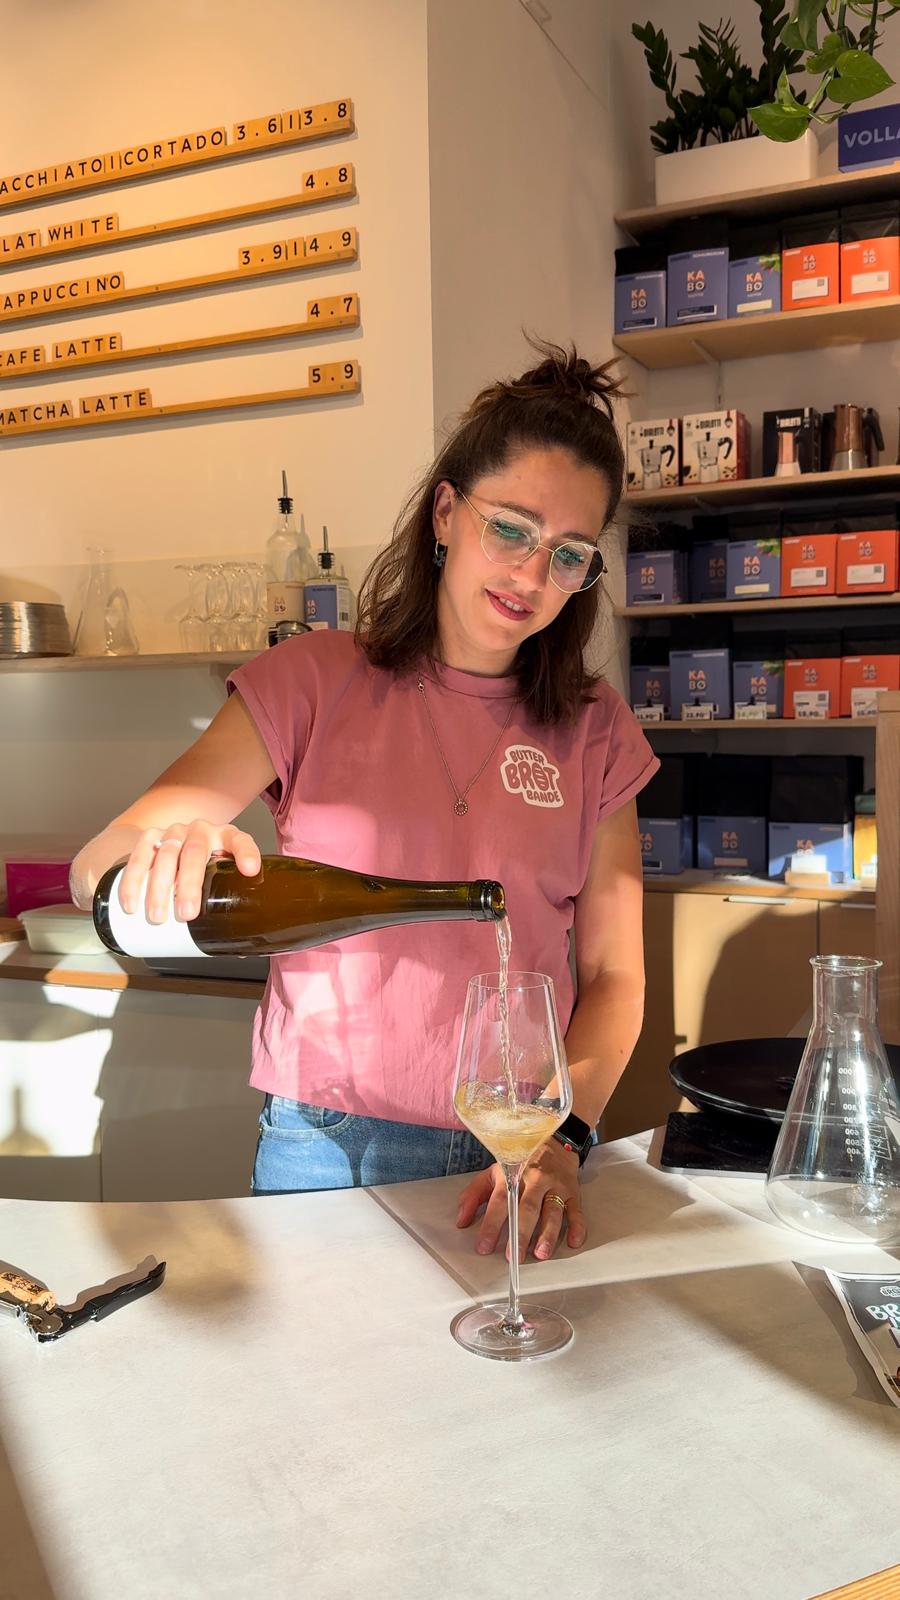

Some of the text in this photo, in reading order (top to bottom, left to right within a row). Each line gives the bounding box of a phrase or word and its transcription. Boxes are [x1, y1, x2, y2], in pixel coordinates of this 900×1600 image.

[3, 167, 348, 252] LAT WHITE 4.8
[687, 270, 705, 281] KA
[746, 272, 763, 282] KA
[687, 281, 705, 291] BO
[746, 282, 763, 292] BO
[3, 275, 121, 310] APPUCCINO
[631, 288, 647, 298] KA
[631, 298, 647, 309] BO
[0, 297, 353, 367] AFE LATTE 4.7
[82, 392, 147, 415] LATTE
[312, 364, 354, 383] 5.9
[744, 556, 760, 566] KA
[744, 566, 760, 575] BO
[688, 670, 705, 680] KA
[688, 680, 706, 690] BO
[751, 677, 767, 686] KA
[751, 686, 767, 695] BO
[509, 749, 544, 766] BUTTER
[505, 761, 556, 791] BROT
[526, 790, 561, 803] BANDE
